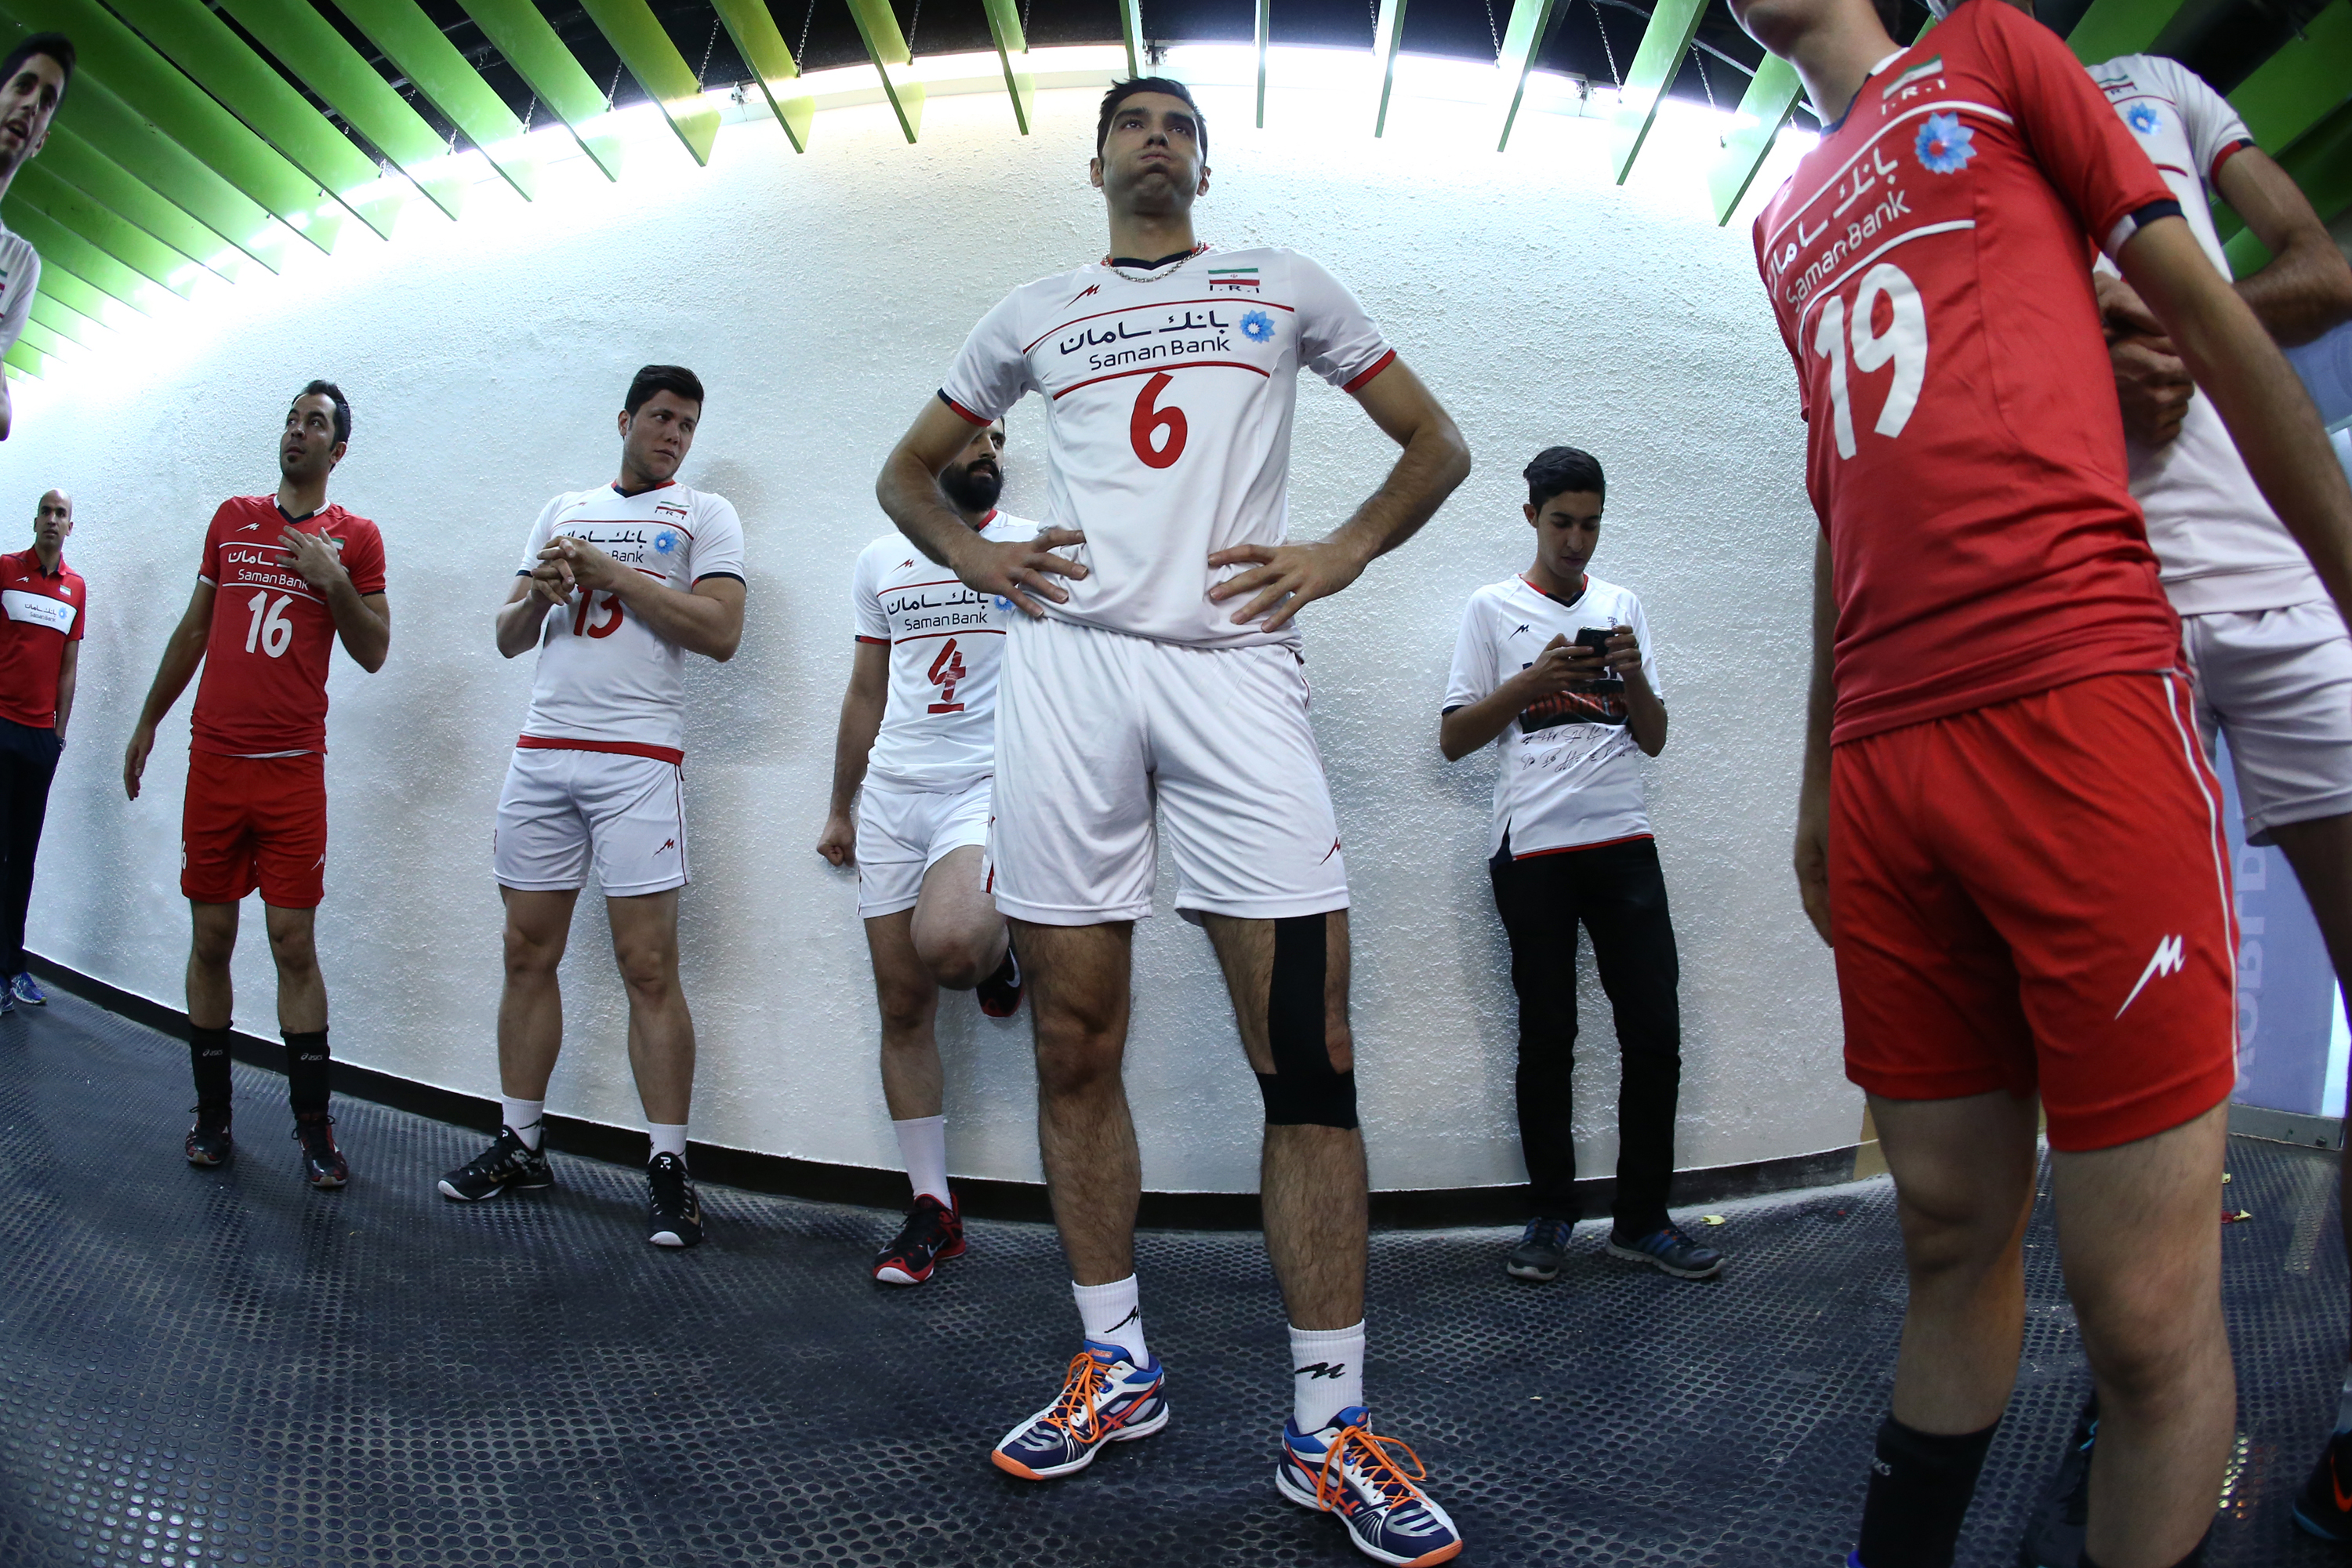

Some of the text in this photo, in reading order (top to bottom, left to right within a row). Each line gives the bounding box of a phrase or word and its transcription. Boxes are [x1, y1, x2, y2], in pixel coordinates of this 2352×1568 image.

[1785, 190, 1911, 314] Saman Bank
[1059, 321, 1152, 356] سامان
[1088, 336, 1232, 372] Saman Bank
[1814, 262, 1928, 461] 19
[1130, 371, 1189, 470] 6
[227, 550, 274, 567] سامان
[612, 550, 644, 564] Bank
[238, 568, 309, 591] Saman Bank
[30, 612, 45, 621] Saman
[887, 594, 942, 616] سامان
[904, 612, 989, 631] Saman Bank
[245, 590, 294, 659] 16
[927, 637, 967, 703] 4
